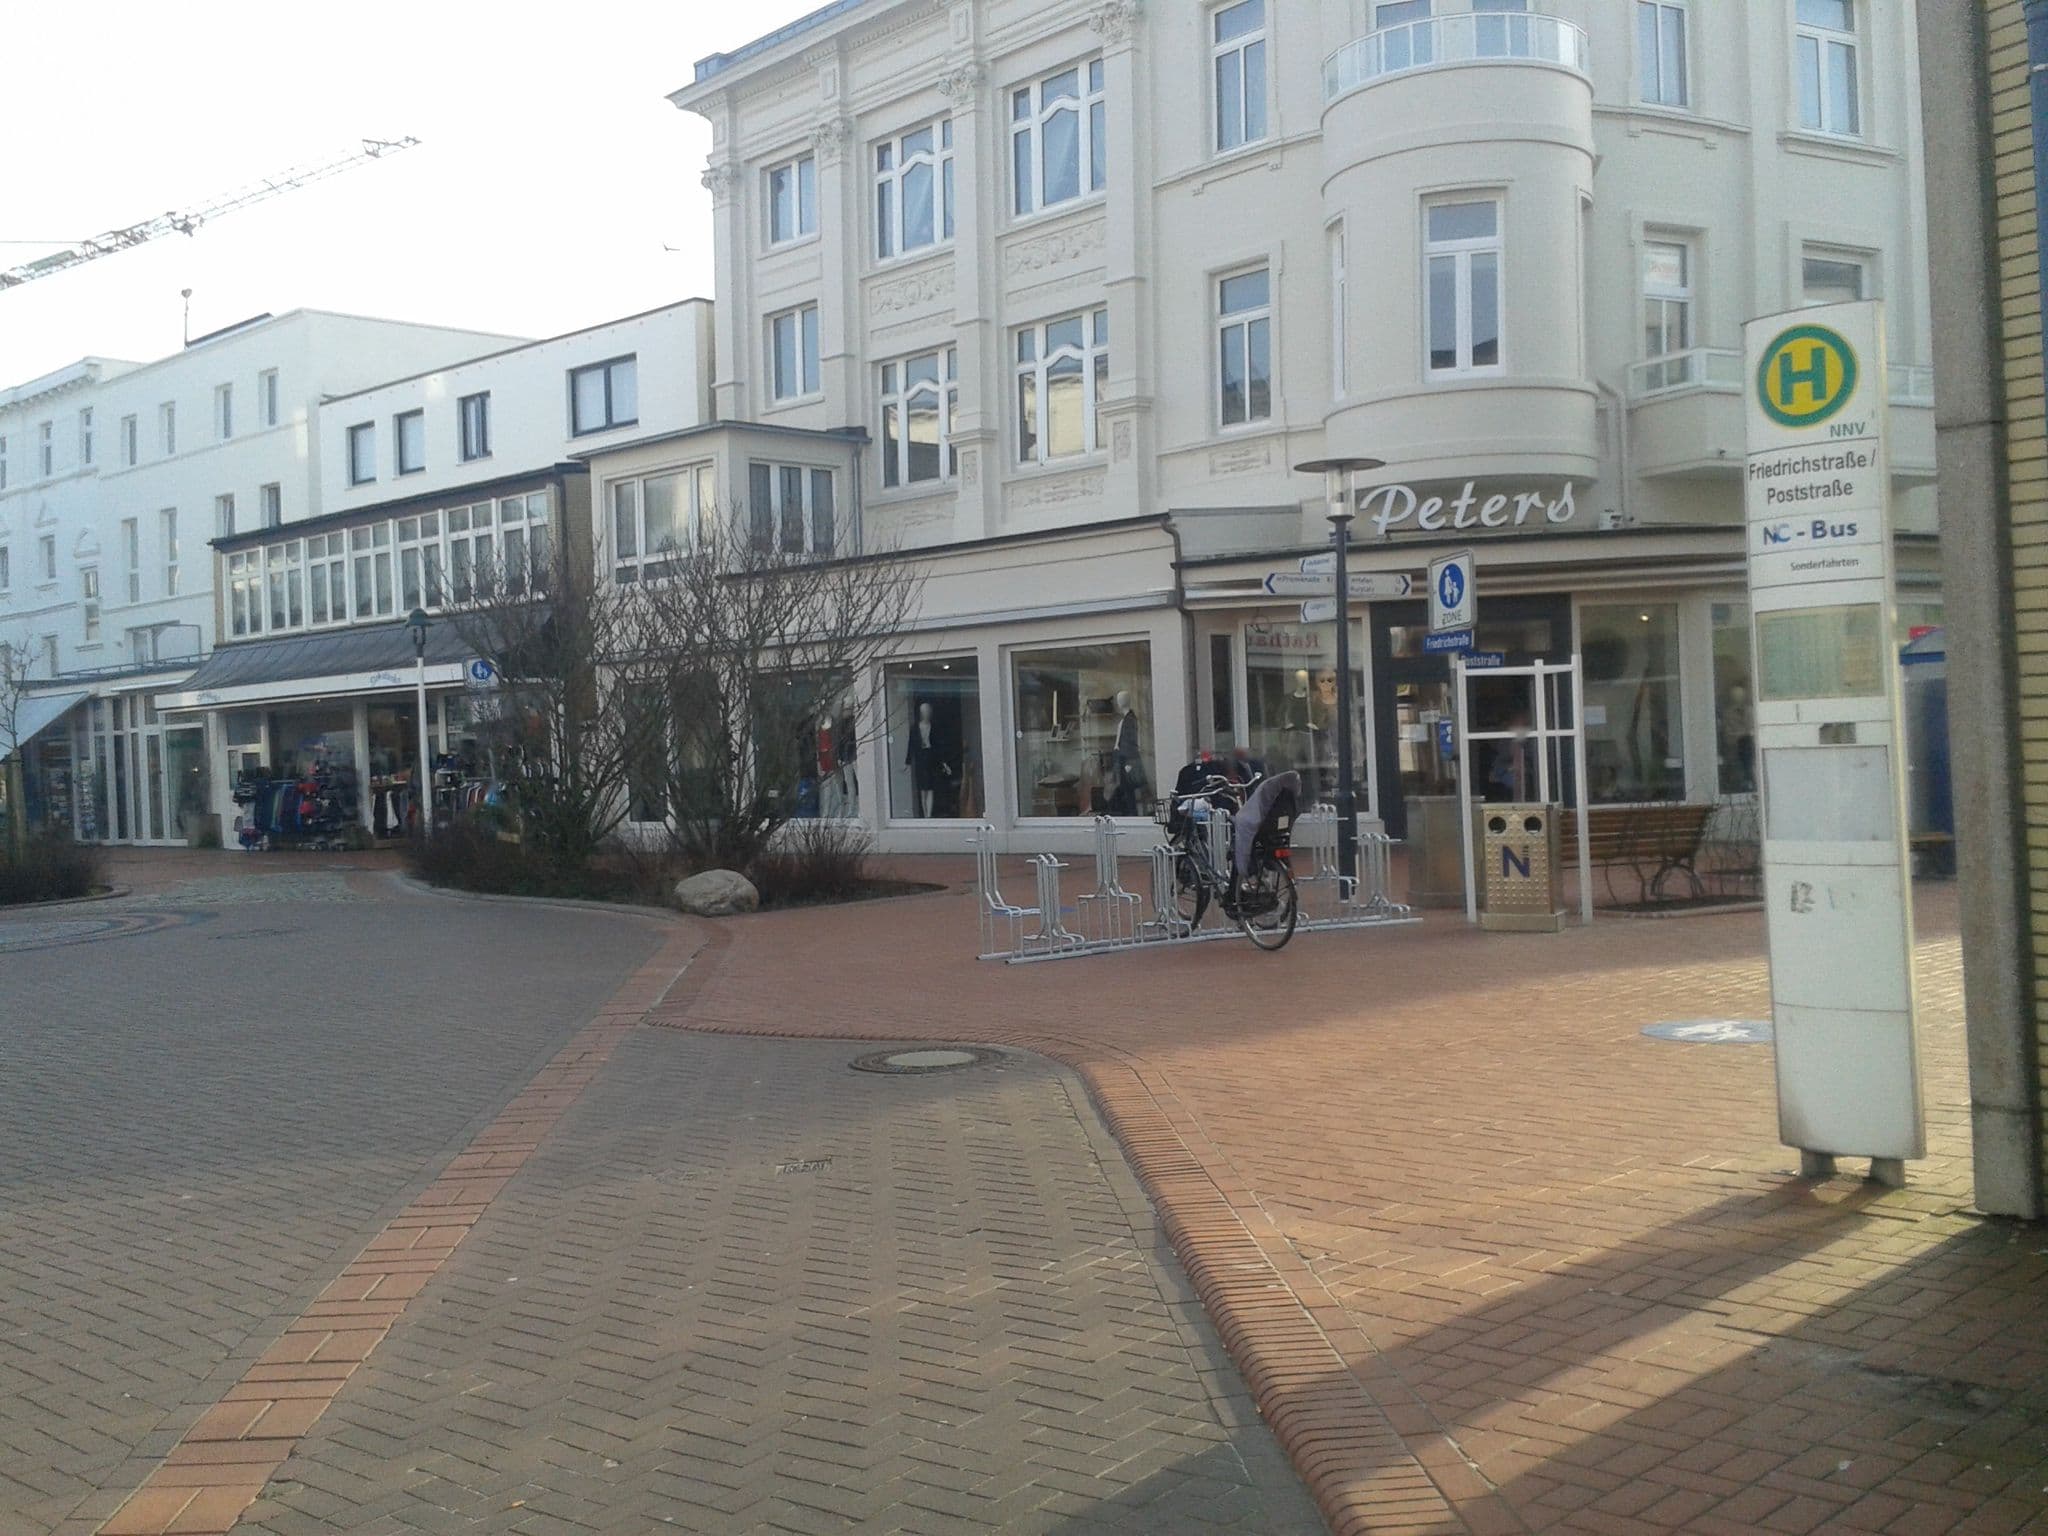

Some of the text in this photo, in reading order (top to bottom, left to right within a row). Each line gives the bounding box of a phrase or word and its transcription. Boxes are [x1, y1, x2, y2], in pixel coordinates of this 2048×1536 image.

[1779, 346, 1827, 405] H
[1829, 422, 1867, 438] NNV
[1748, 451, 1867, 480] Friedrichstraße
[1766, 479, 1854, 505] Poststraße
[1359, 481, 1576, 536] Peters
[1789, 558, 1860, 572] Sonderfahrten
[1441, 609, 1463, 626] ZONE
